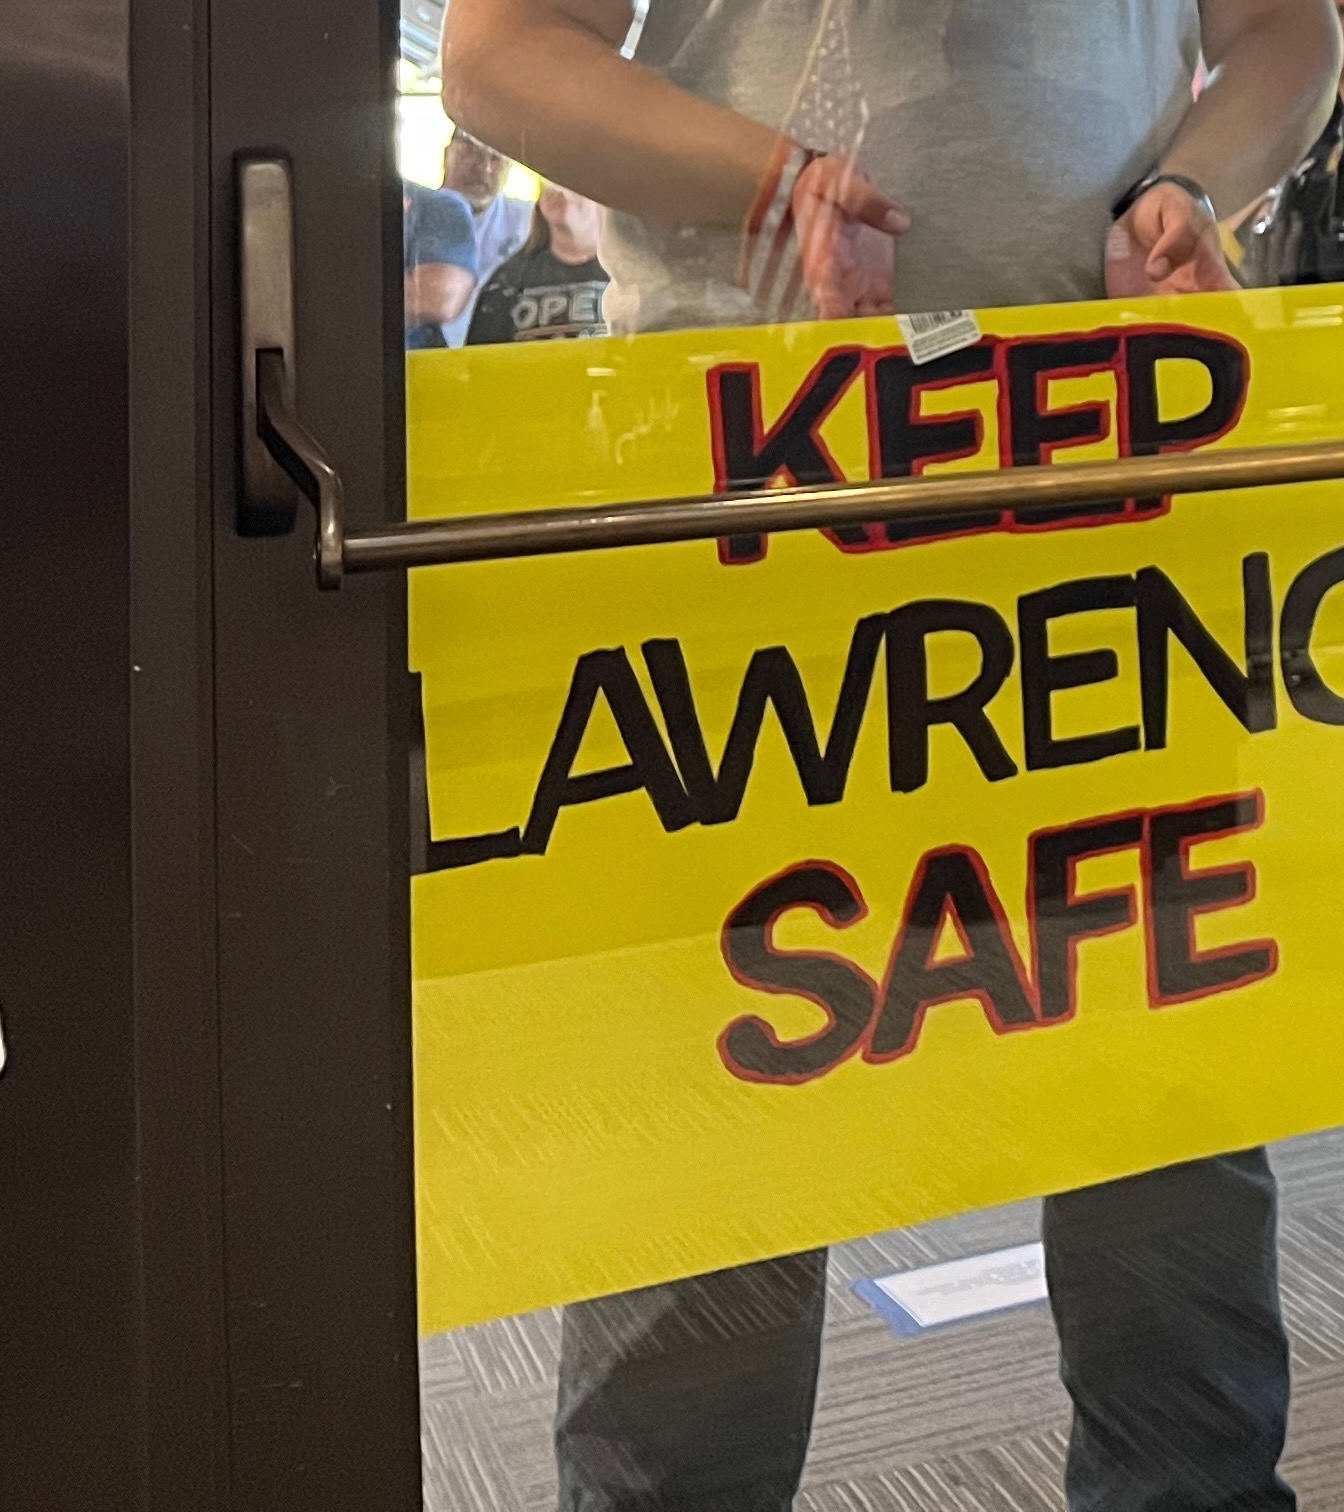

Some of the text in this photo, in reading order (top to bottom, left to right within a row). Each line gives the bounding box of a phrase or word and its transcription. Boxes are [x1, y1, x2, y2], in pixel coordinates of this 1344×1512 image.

[511, 288, 603, 330] OPE
[706, 322, 1250, 566] KEEP
[717, 788, 1278, 1085] SAFE
